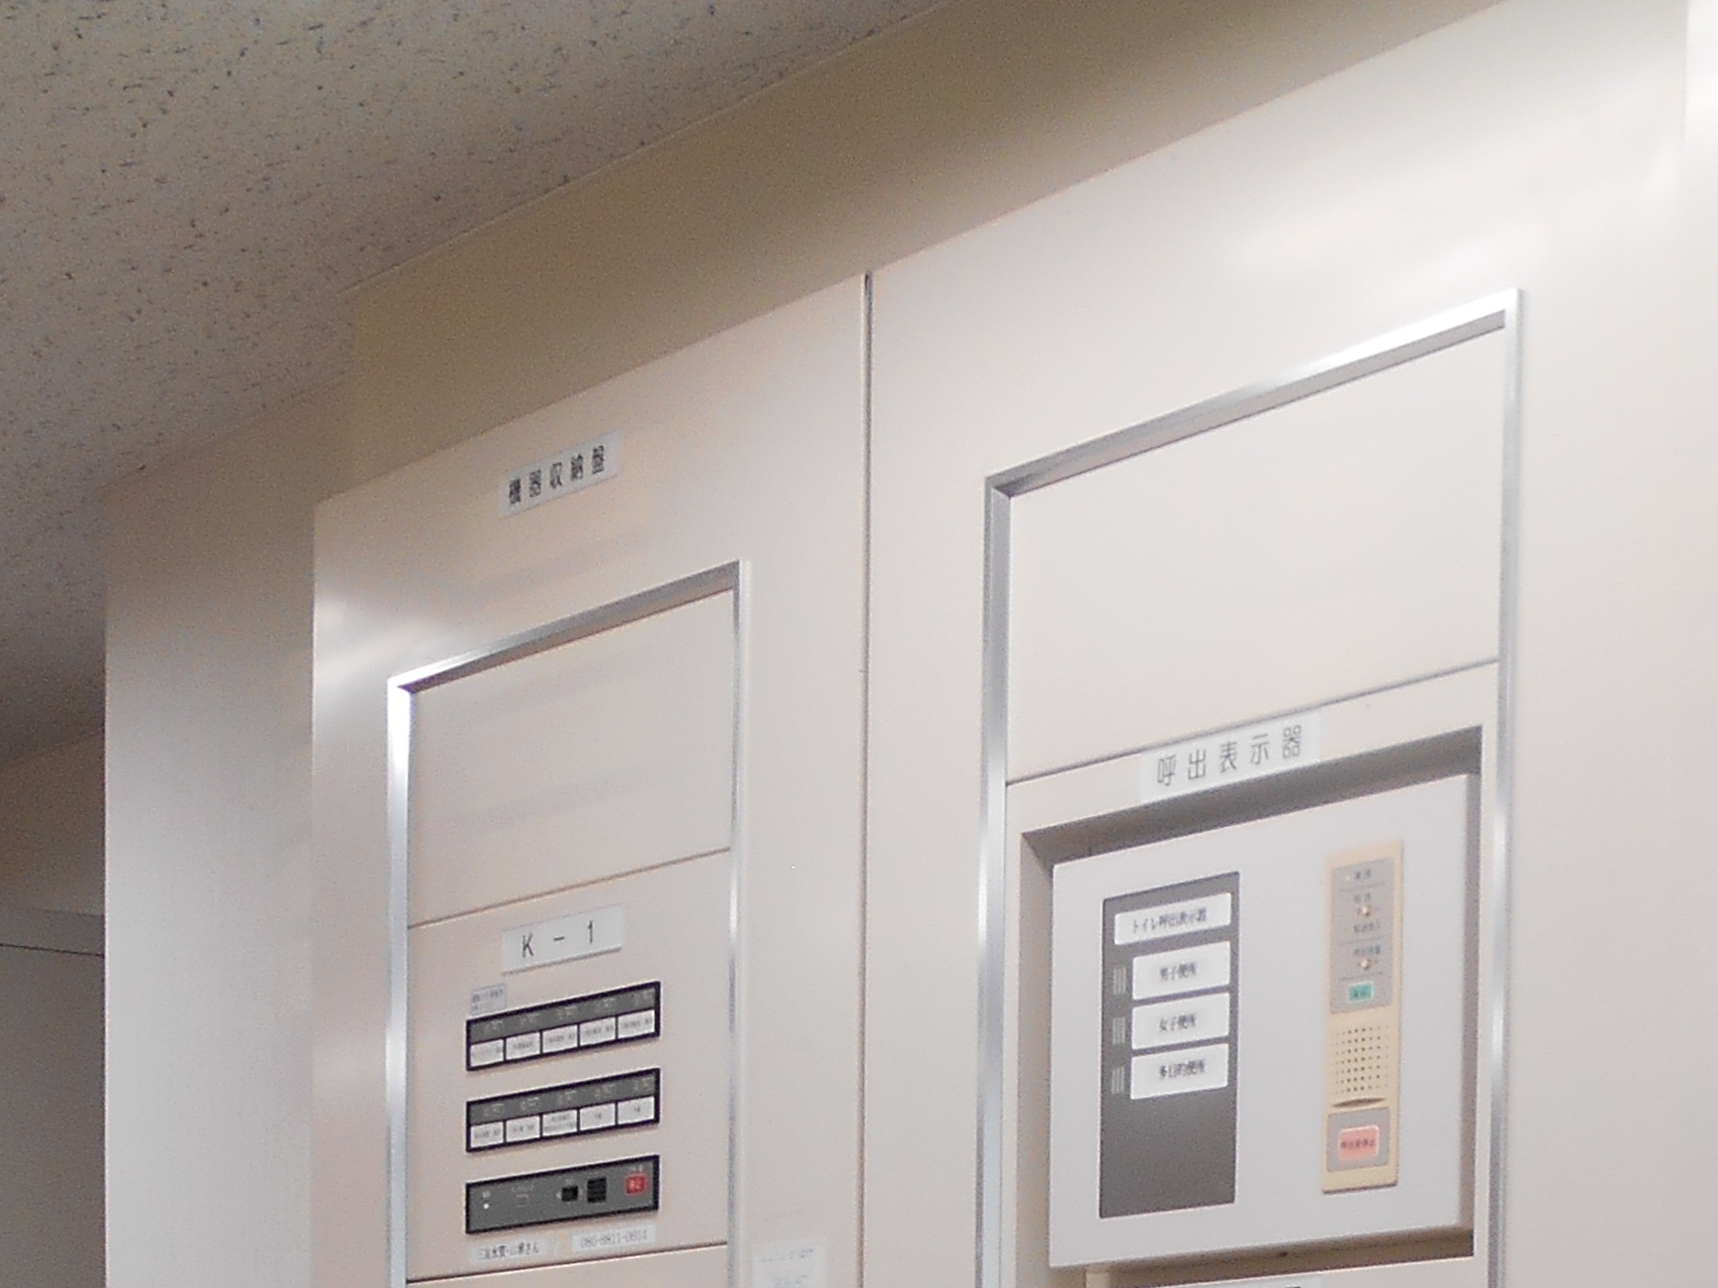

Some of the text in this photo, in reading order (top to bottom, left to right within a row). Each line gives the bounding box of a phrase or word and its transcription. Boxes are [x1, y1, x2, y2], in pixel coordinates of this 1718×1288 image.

[508, 444, 606, 505] 機器収納盤
[1156, 724, 1303, 787] 呼出表示器
[1159, 962, 1197, 982] 男子便所
[1159, 1013, 1197, 1033] 女子便所
[1159, 1059, 1205, 1080] 多目的便所
